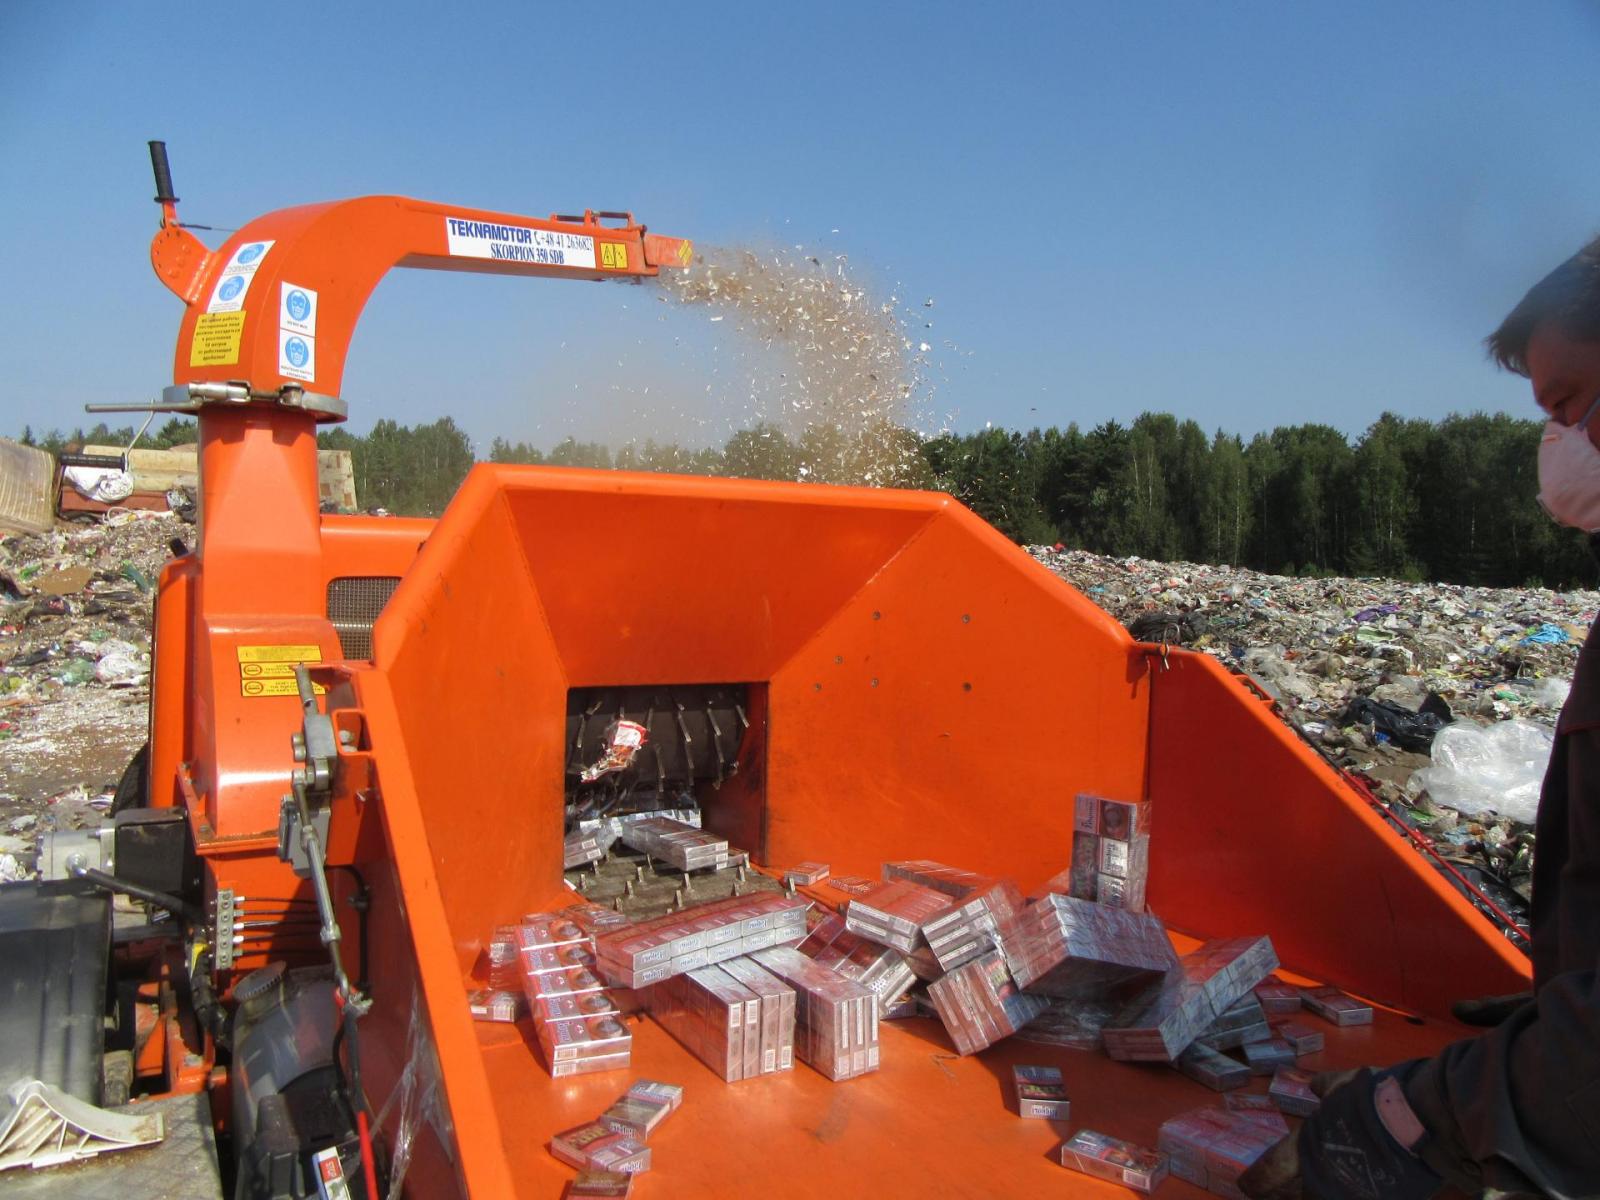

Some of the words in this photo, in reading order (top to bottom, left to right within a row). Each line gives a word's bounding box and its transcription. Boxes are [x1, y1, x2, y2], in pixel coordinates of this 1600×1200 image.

[449, 219, 531, 244] TEKNAMOTOR
[490, 242, 535, 262] SKORPION
[536, 248, 549, 263] 350
[549, 250, 564, 265] SDB
